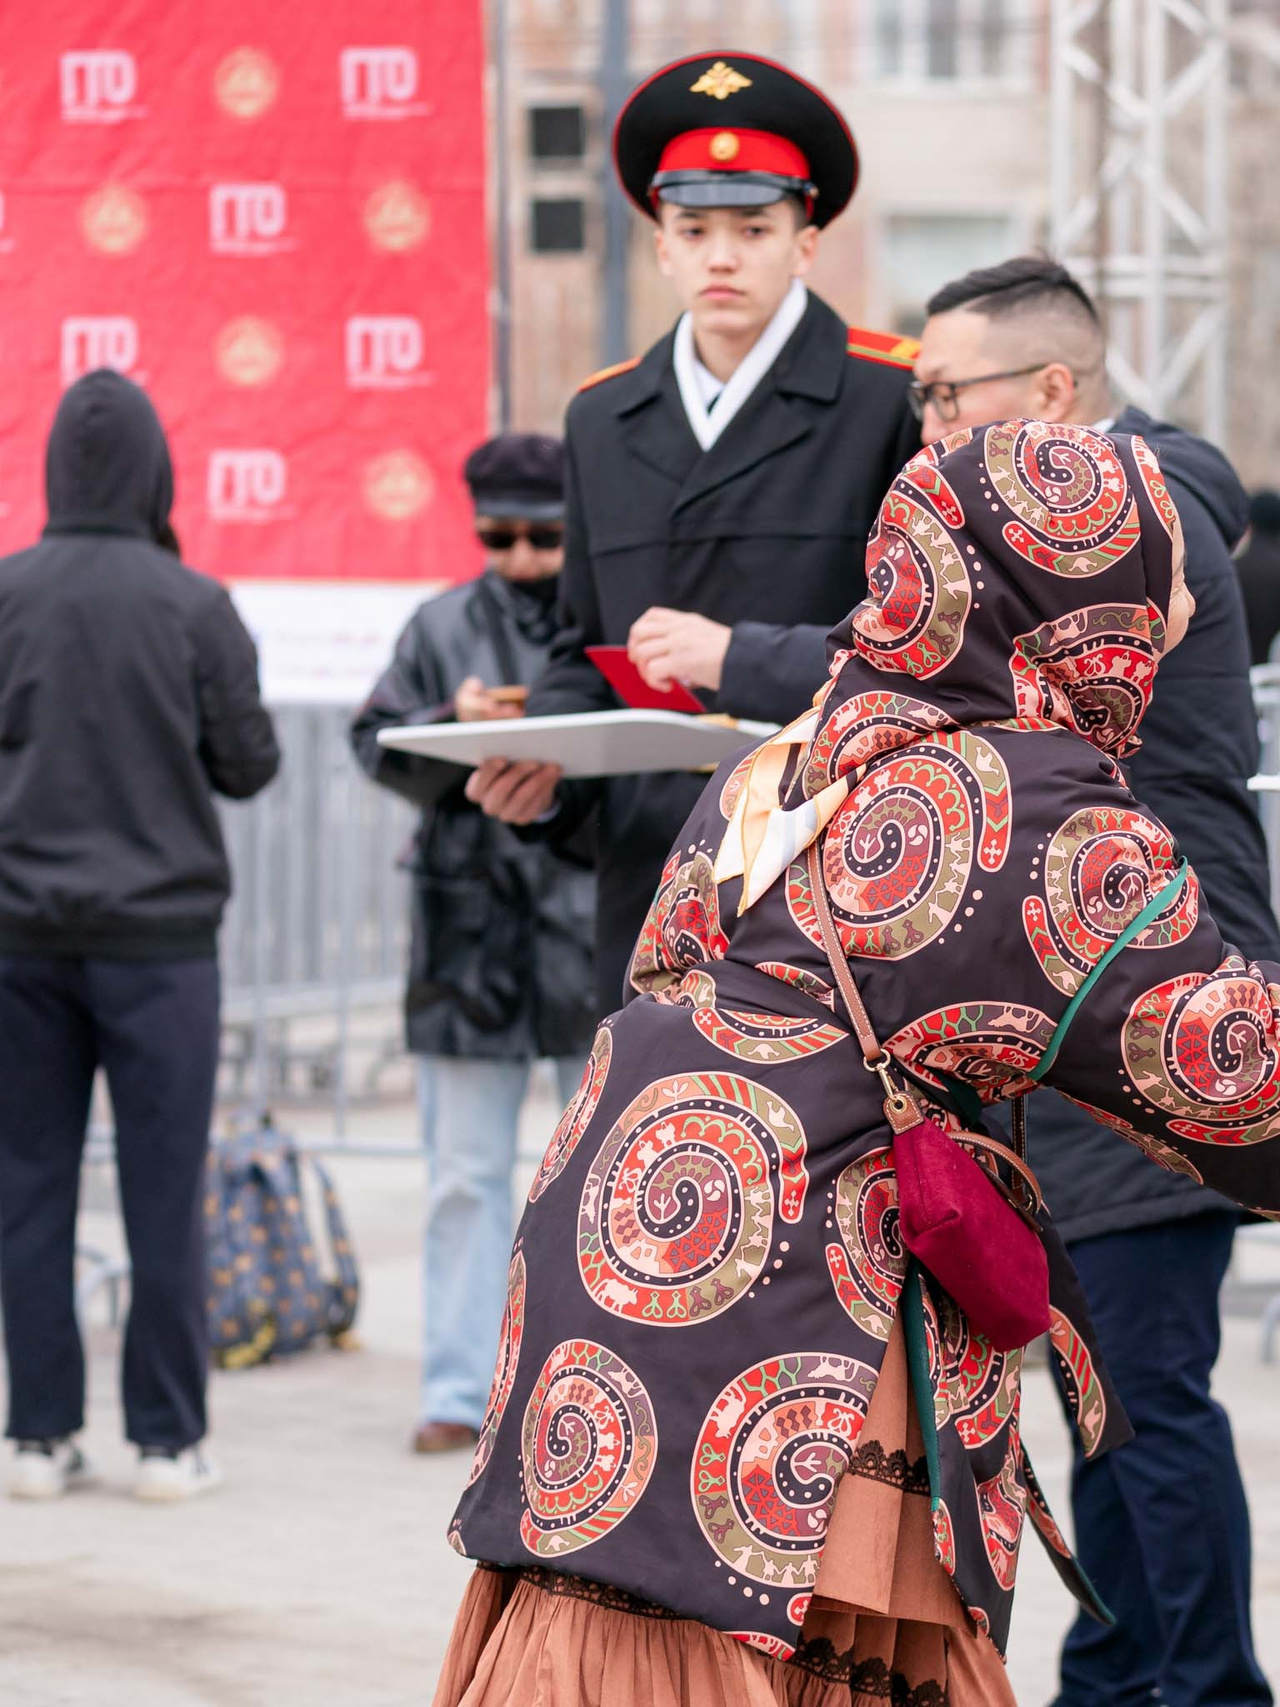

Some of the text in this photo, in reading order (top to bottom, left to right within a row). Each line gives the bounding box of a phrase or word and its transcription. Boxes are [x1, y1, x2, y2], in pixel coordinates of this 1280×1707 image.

[60, 49, 136, 106] ГТО
[340, 47, 417, 104] ГТО
[210, 183, 287, 241] ГТО
[62, 316, 138, 376] ГТО
[346, 316, 423, 373] ГТО
[208, 450, 286, 508] ГТО
